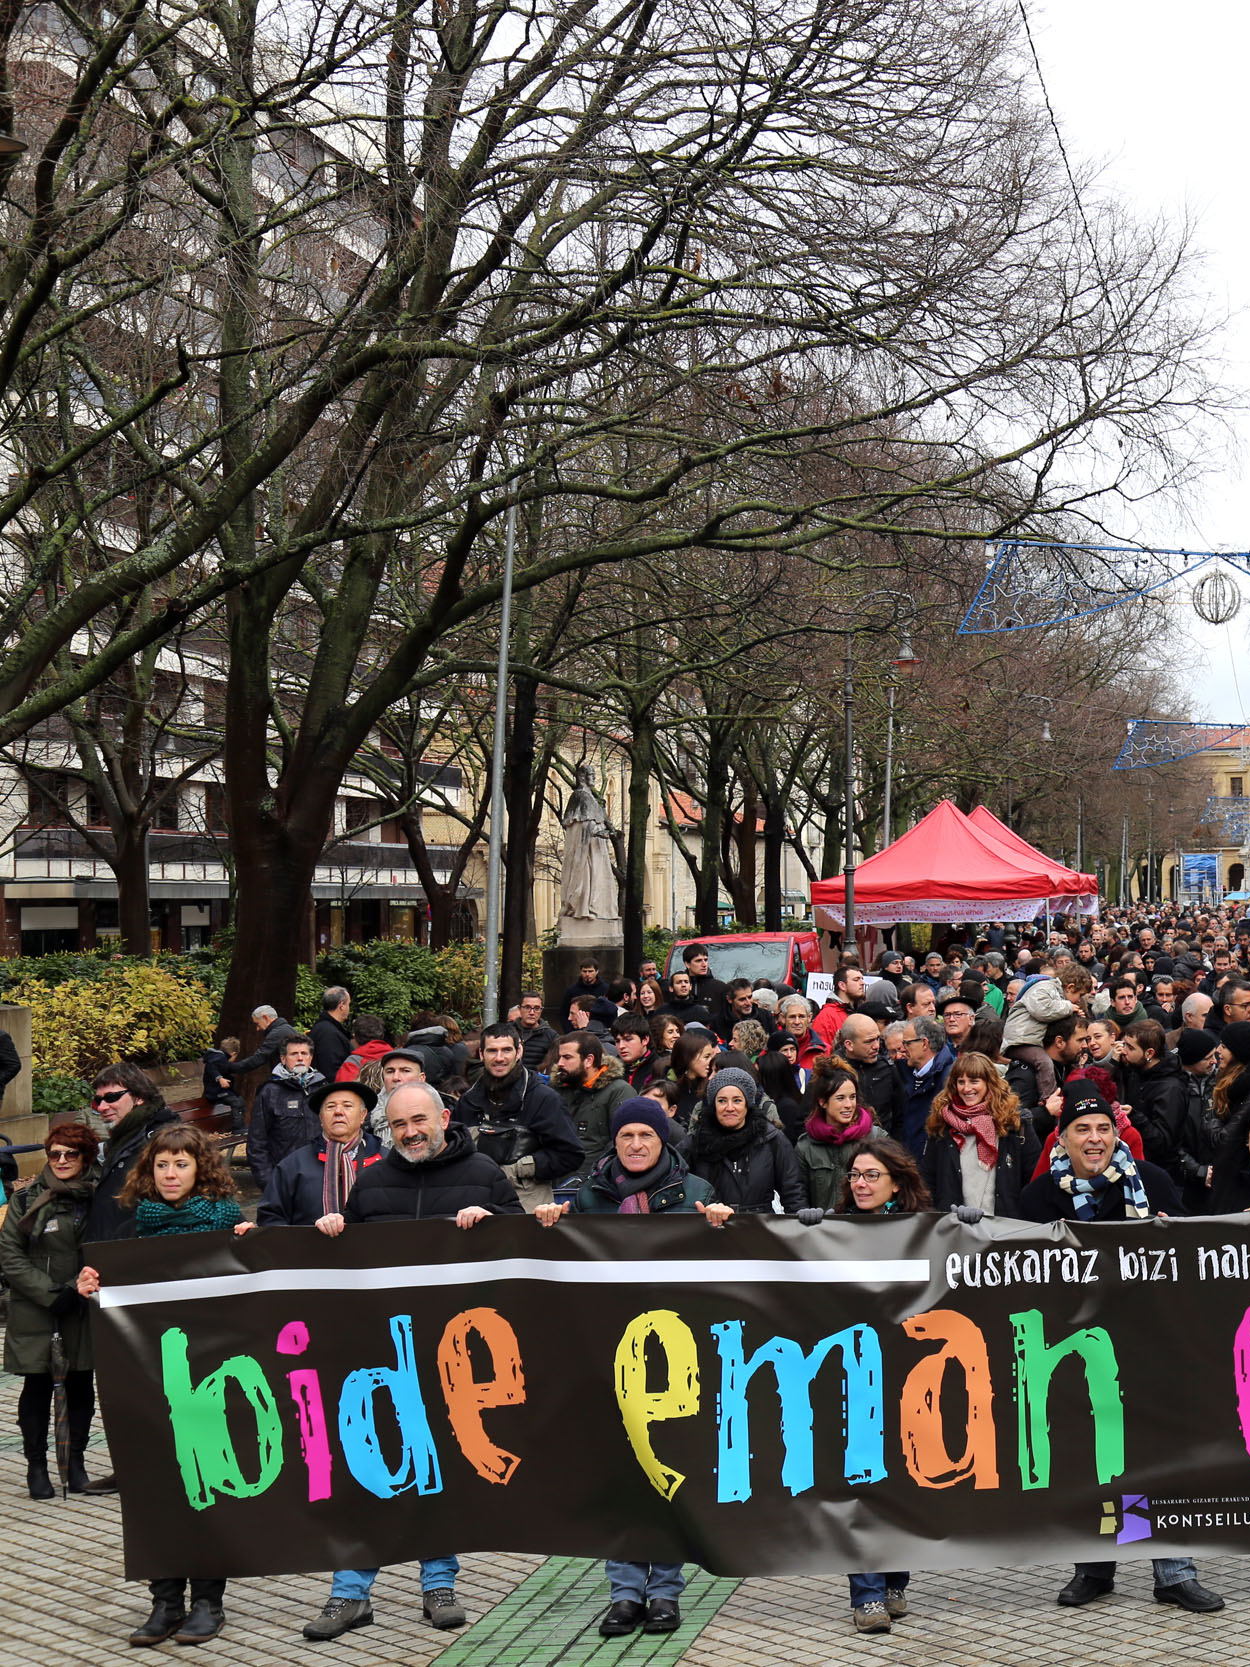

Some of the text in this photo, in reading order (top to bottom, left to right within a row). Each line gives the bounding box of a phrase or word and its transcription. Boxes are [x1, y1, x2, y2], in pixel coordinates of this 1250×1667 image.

[946, 1247, 1099, 1289] euskaraz
[1118, 1245, 1178, 1282] bizi
[161, 1307, 526, 1512] bide
[613, 1309, 1125, 1503] eman
